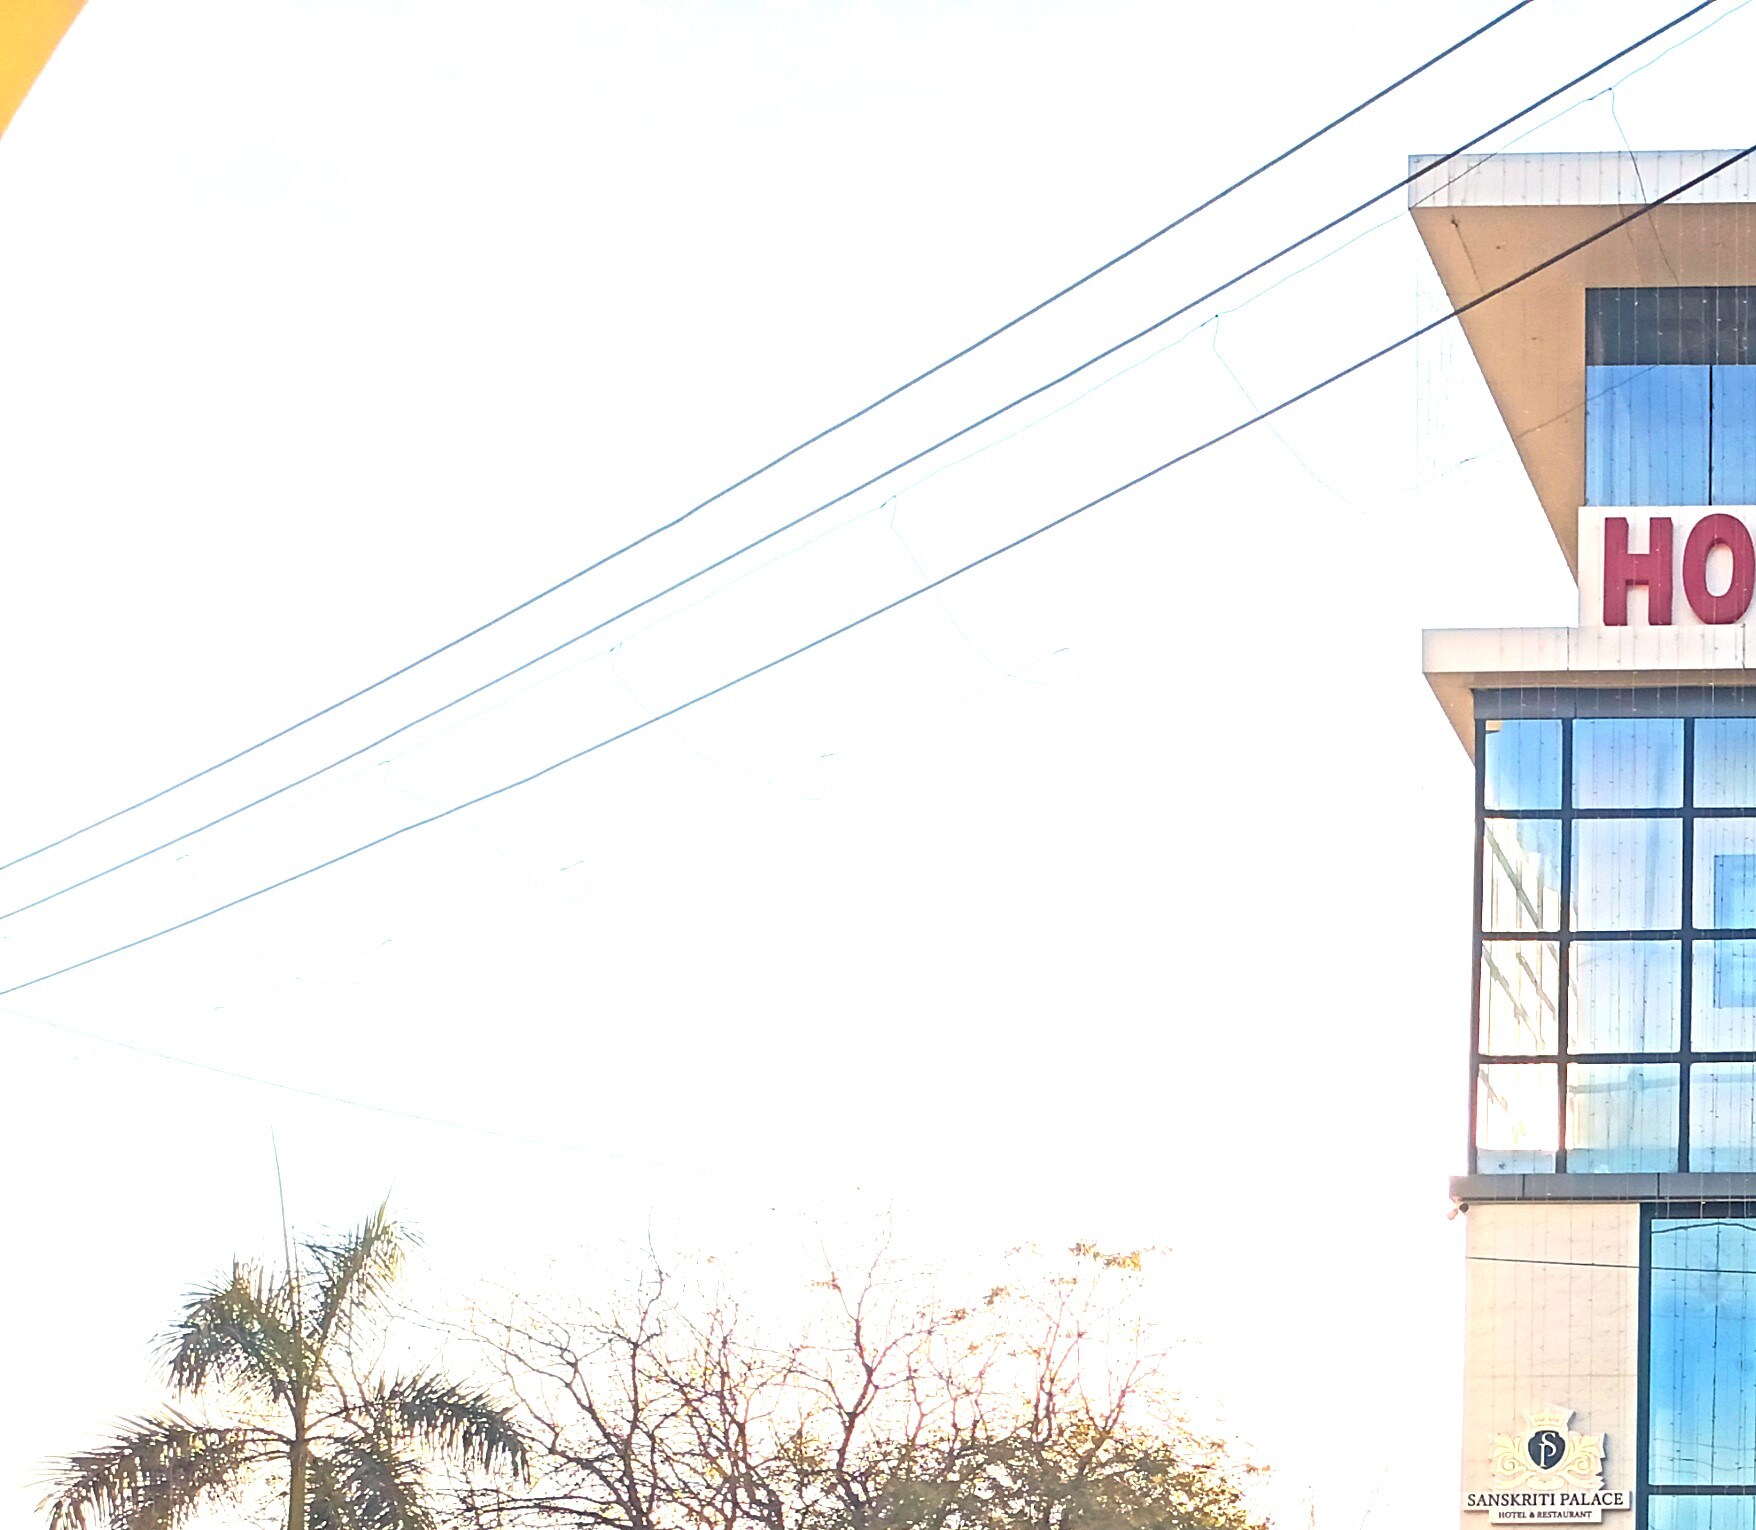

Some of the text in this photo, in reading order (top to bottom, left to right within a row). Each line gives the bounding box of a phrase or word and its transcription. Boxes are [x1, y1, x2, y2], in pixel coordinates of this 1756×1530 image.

[1467, 1492, 1624, 1507] SANSKRITI PALACE
[1498, 1510, 1593, 1519] HOTEL & RESTAURANT
